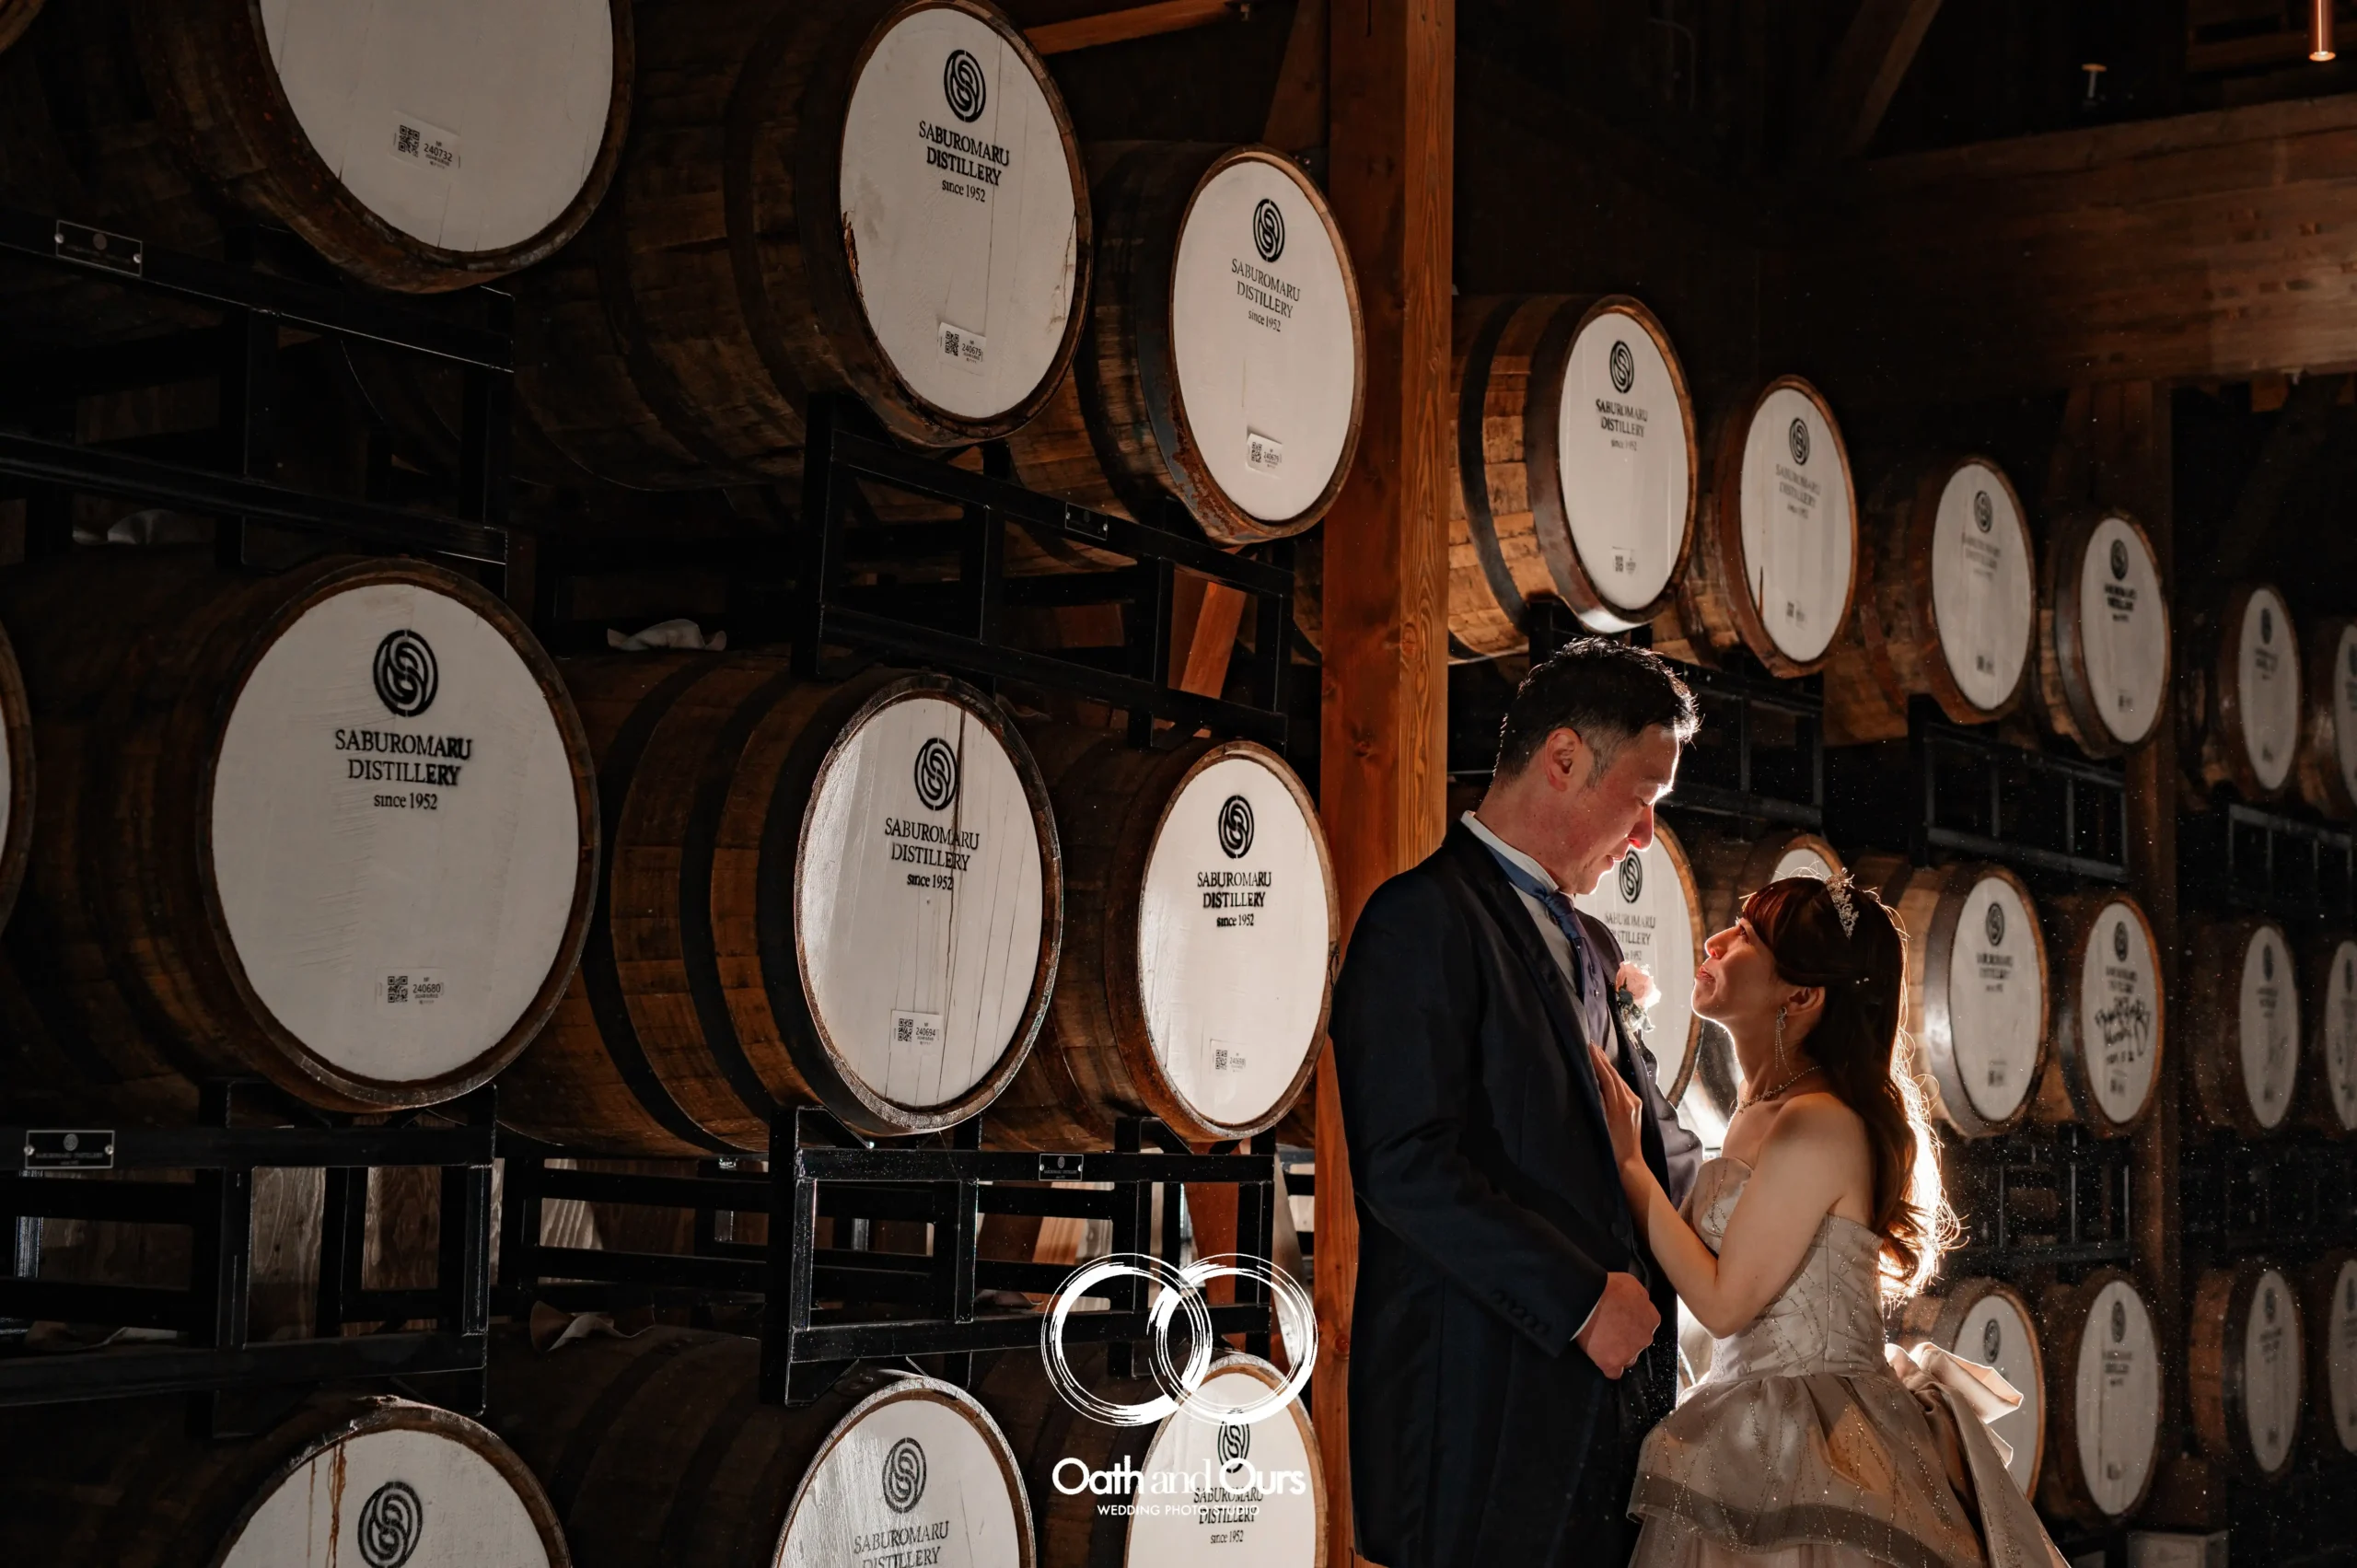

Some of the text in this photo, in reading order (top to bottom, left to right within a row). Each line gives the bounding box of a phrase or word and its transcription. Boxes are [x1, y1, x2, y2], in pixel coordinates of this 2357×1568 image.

[424, 143, 453, 162] 240732
[919, 120, 1009, 167] SABUROMARU
[926, 145, 1002, 187] DISTILLERY
[942, 180, 986, 203] since 1952
[1231, 258, 1301, 302] SABUROMARU
[1237, 280, 1294, 319] DISTILLERY
[1248, 309, 1282, 332] since 1952
[961, 343, 982, 357] 240675
[335, 729, 472, 761] SABUROMARU
[347, 759, 461, 786] DISTILLERY
[374, 792, 438, 810] since 1952
[885, 817, 980, 851] SABUROMARU
[891, 842, 970, 872] DISTILLERY
[907, 873, 954, 890] since 1952
[1197, 871, 1272, 888] SABUROMARU
[1202, 891, 1266, 909] DISTILLERY
[1216, 912, 1255, 927] since 1952
[412, 983, 441, 993] 240680
[853, 1520, 949, 1554] SABUROMARU
[1229, 1529, 1244, 1543] 1952
